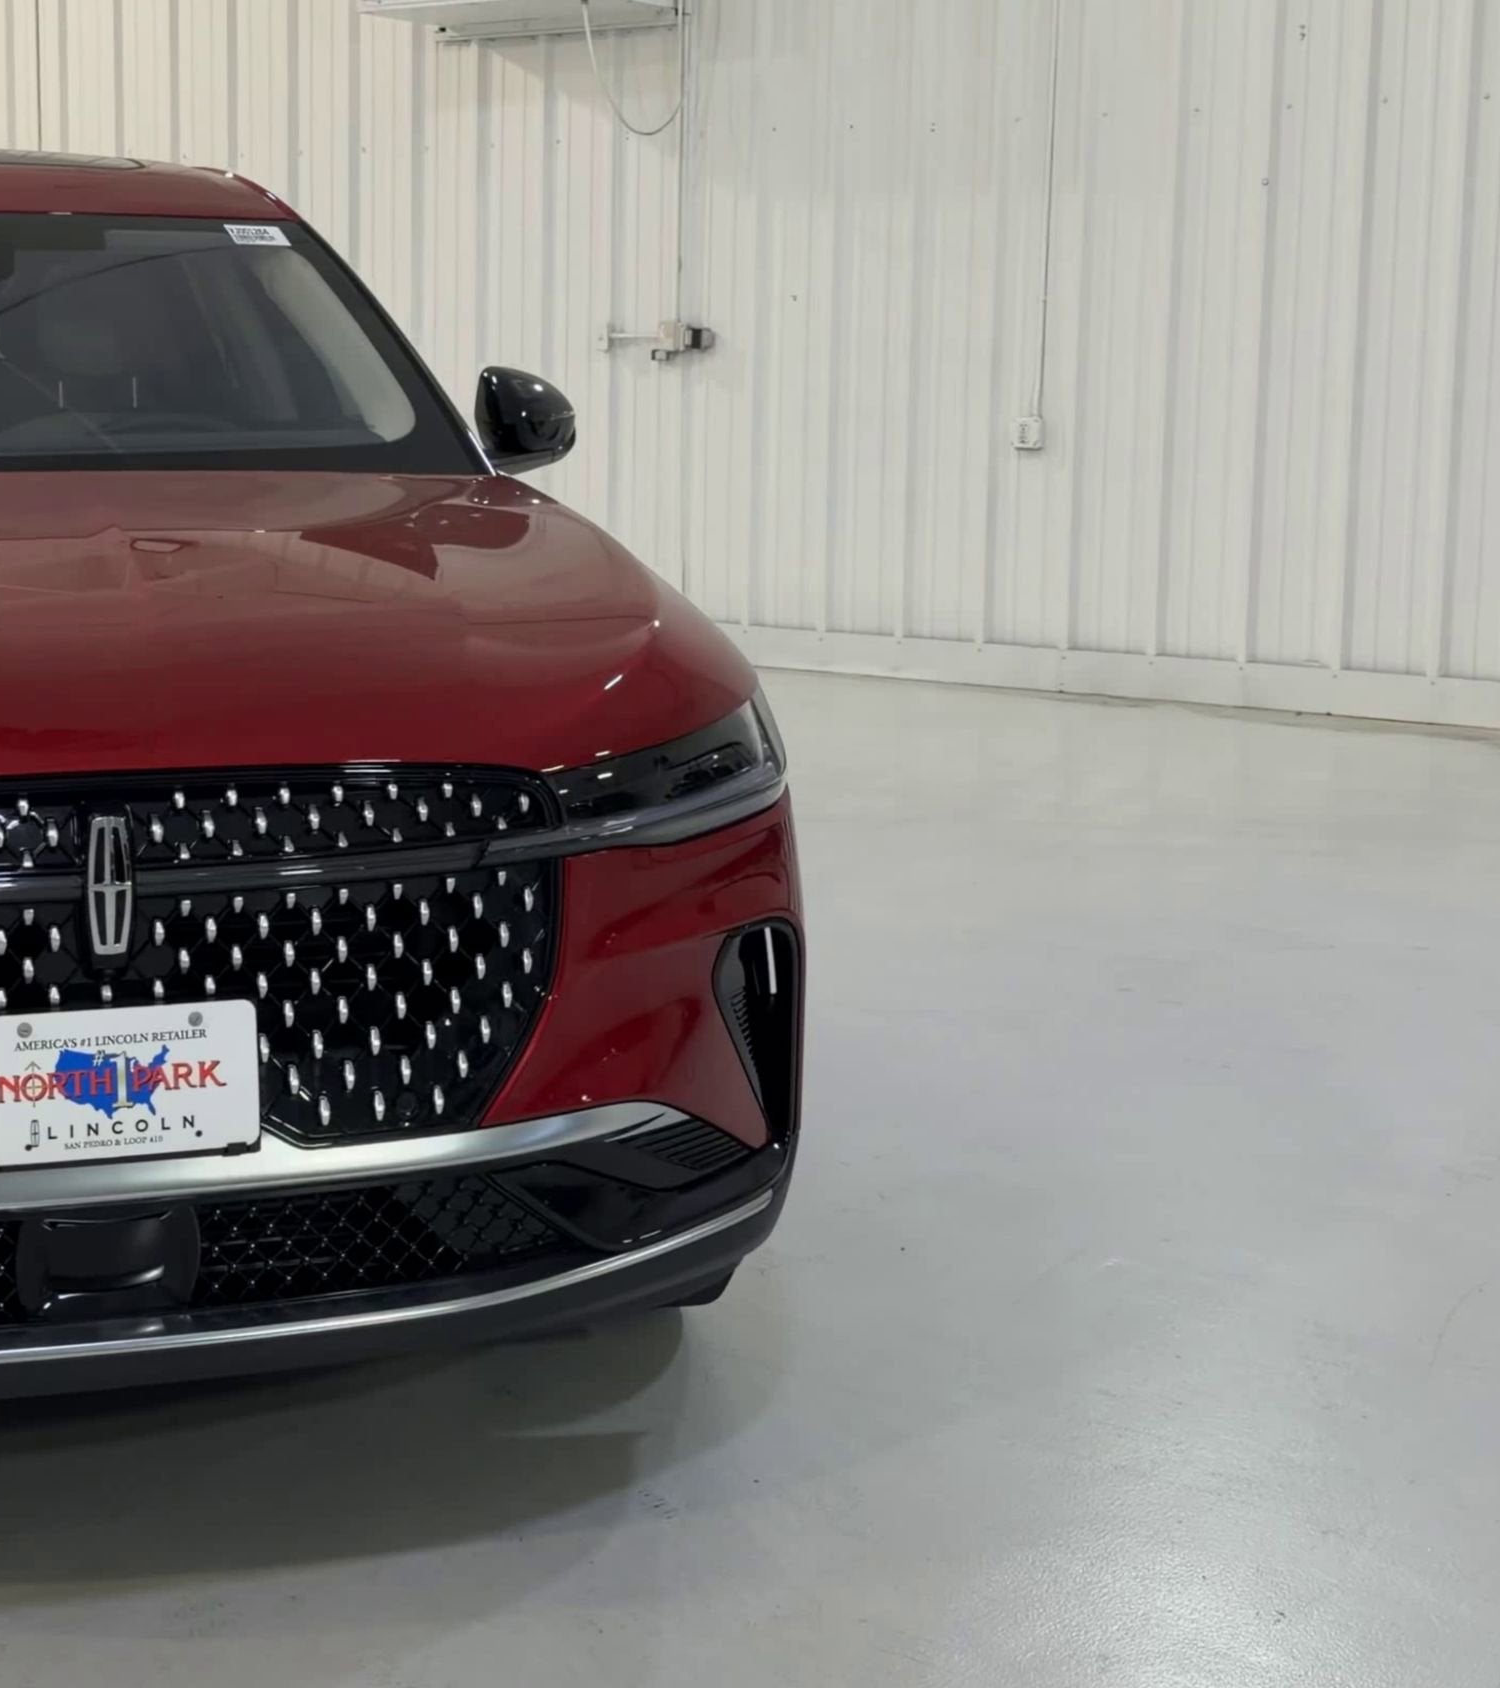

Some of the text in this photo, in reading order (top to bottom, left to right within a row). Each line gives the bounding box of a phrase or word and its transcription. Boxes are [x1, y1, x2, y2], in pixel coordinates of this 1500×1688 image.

[14, 1028, 208, 1052] AMERICA'S #1 LINCOLN RETAILER
[132, 1060, 228, 1094] PARK
[47, 1115, 196, 1140] LINCOLN
[64, 1142, 81, 1150] SAN
